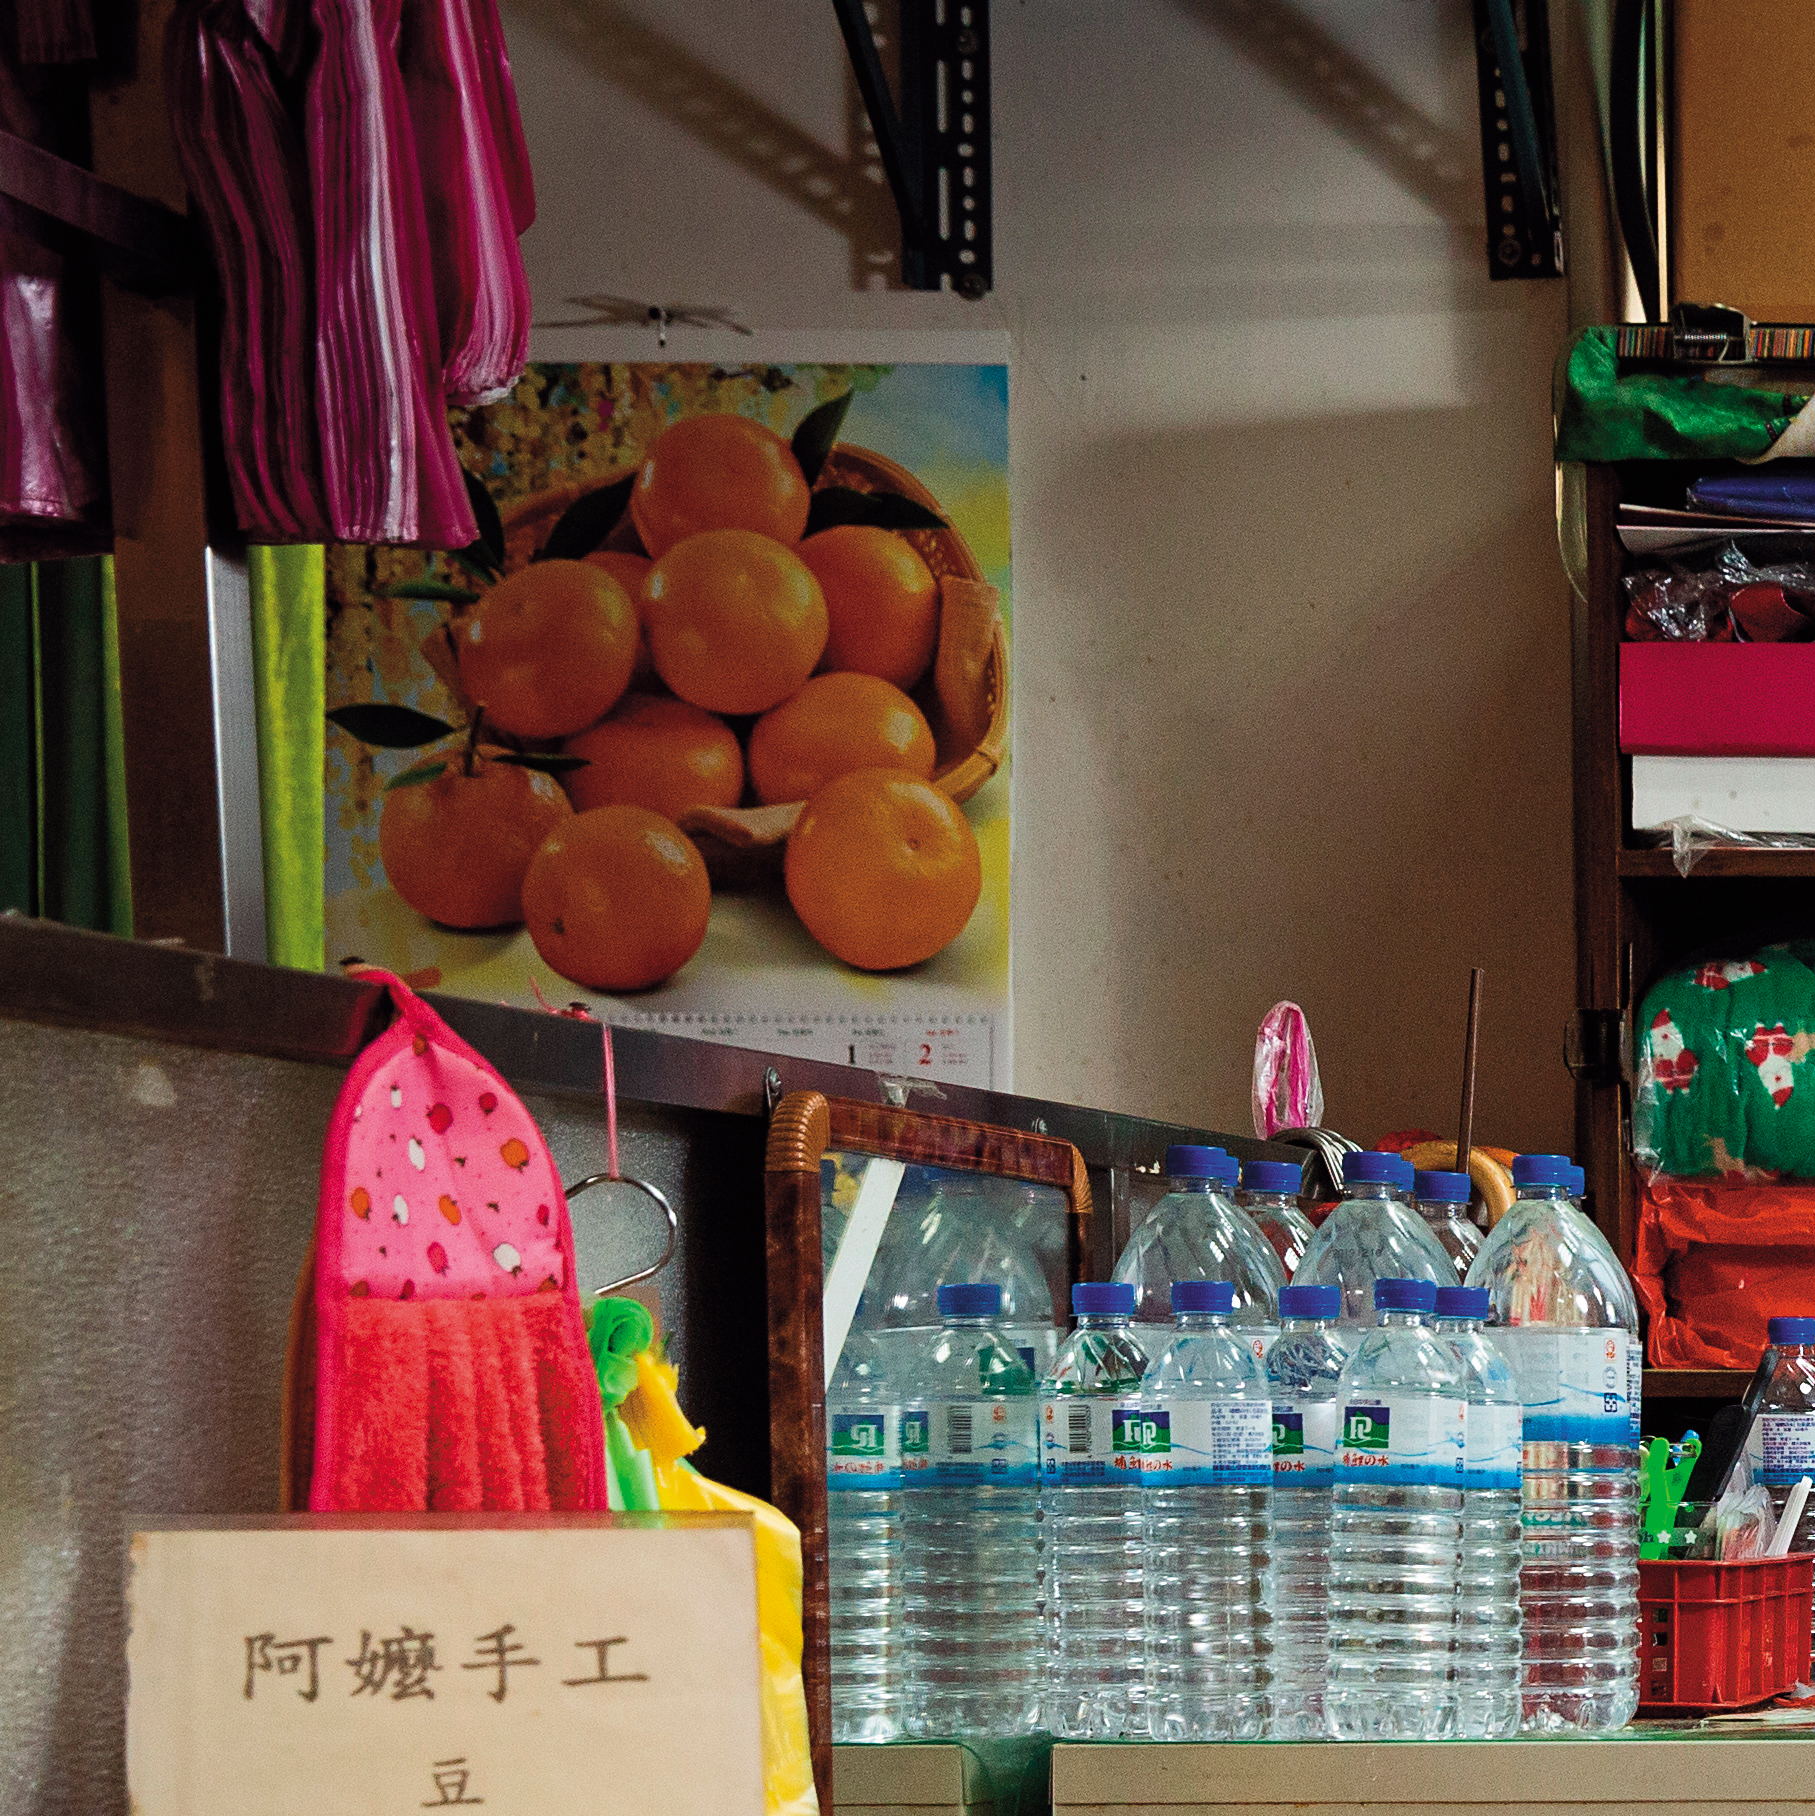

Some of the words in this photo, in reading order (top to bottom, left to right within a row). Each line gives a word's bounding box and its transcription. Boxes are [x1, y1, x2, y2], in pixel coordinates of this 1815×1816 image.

[919, 1044, 932, 1065] 2
[243, 1624, 651, 1703] 阿嬤手工
